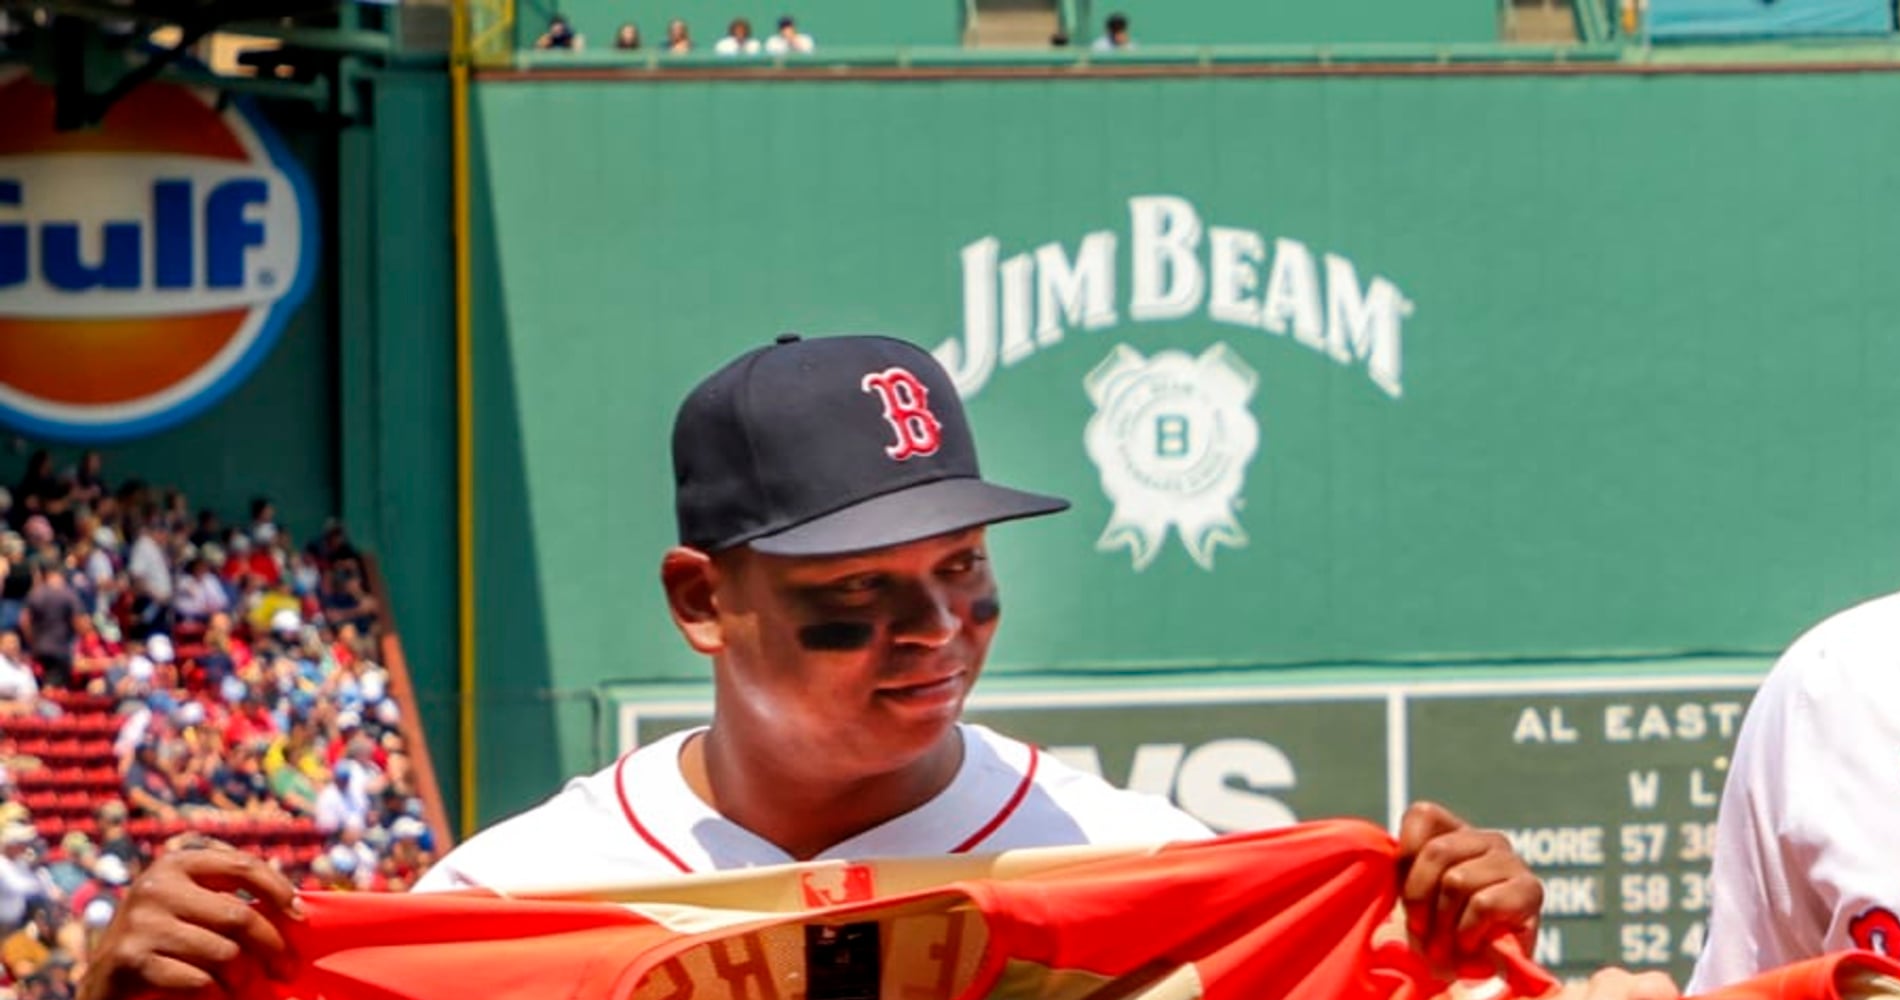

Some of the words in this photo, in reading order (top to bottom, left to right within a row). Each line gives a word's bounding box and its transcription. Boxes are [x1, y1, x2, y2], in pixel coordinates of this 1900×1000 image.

[0, 178, 269, 289] ulf
[931, 230, 1117, 400] JIM
[1129, 195, 1402, 398] BEAM
[862, 366, 942, 460] B
[1156, 416, 1189, 456] B
[1513, 707, 1577, 743] AL
[1604, 703, 1741, 741] EAST
[1628, 772, 1659, 806] W
[1691, 770, 1717, 804] L
[1620, 823, 1668, 864] 57
[1542, 876, 1597, 915] RK
[1620, 873, 1670, 914] 58
[1620, 924, 1671, 964] 52
